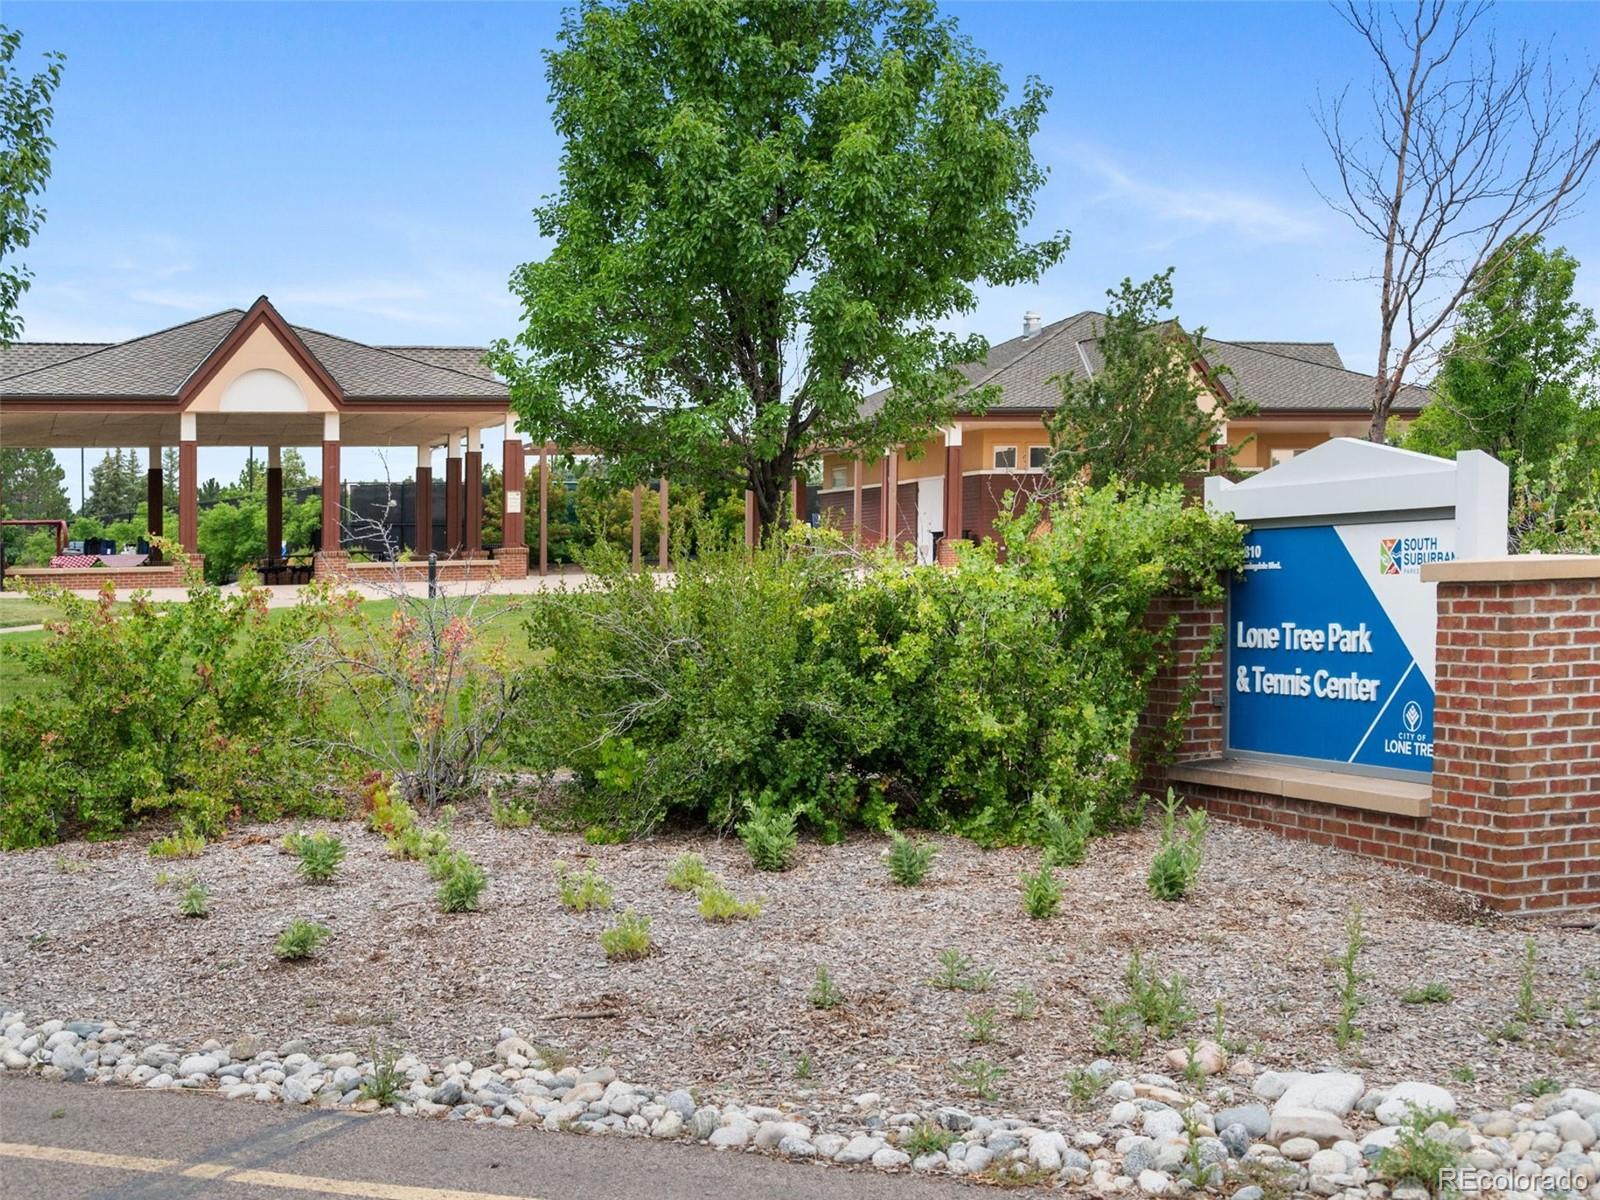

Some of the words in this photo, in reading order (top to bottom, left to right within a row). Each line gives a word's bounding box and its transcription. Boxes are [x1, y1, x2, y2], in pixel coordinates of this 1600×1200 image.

[1403, 537, 1437, 551] SOUTH
[1237, 621, 1280, 649] Lone
[1281, 622, 1325, 651] Tree
[1328, 622, 1373, 653] Park
[1236, 665, 1251, 693] &
[1252, 666, 1311, 697] Tennis
[1313, 669, 1380, 702] Center
[1398, 732, 1415, 741] CITY
[1416, 734, 1427, 742] OF
[1384, 739, 1412, 755] LONE
